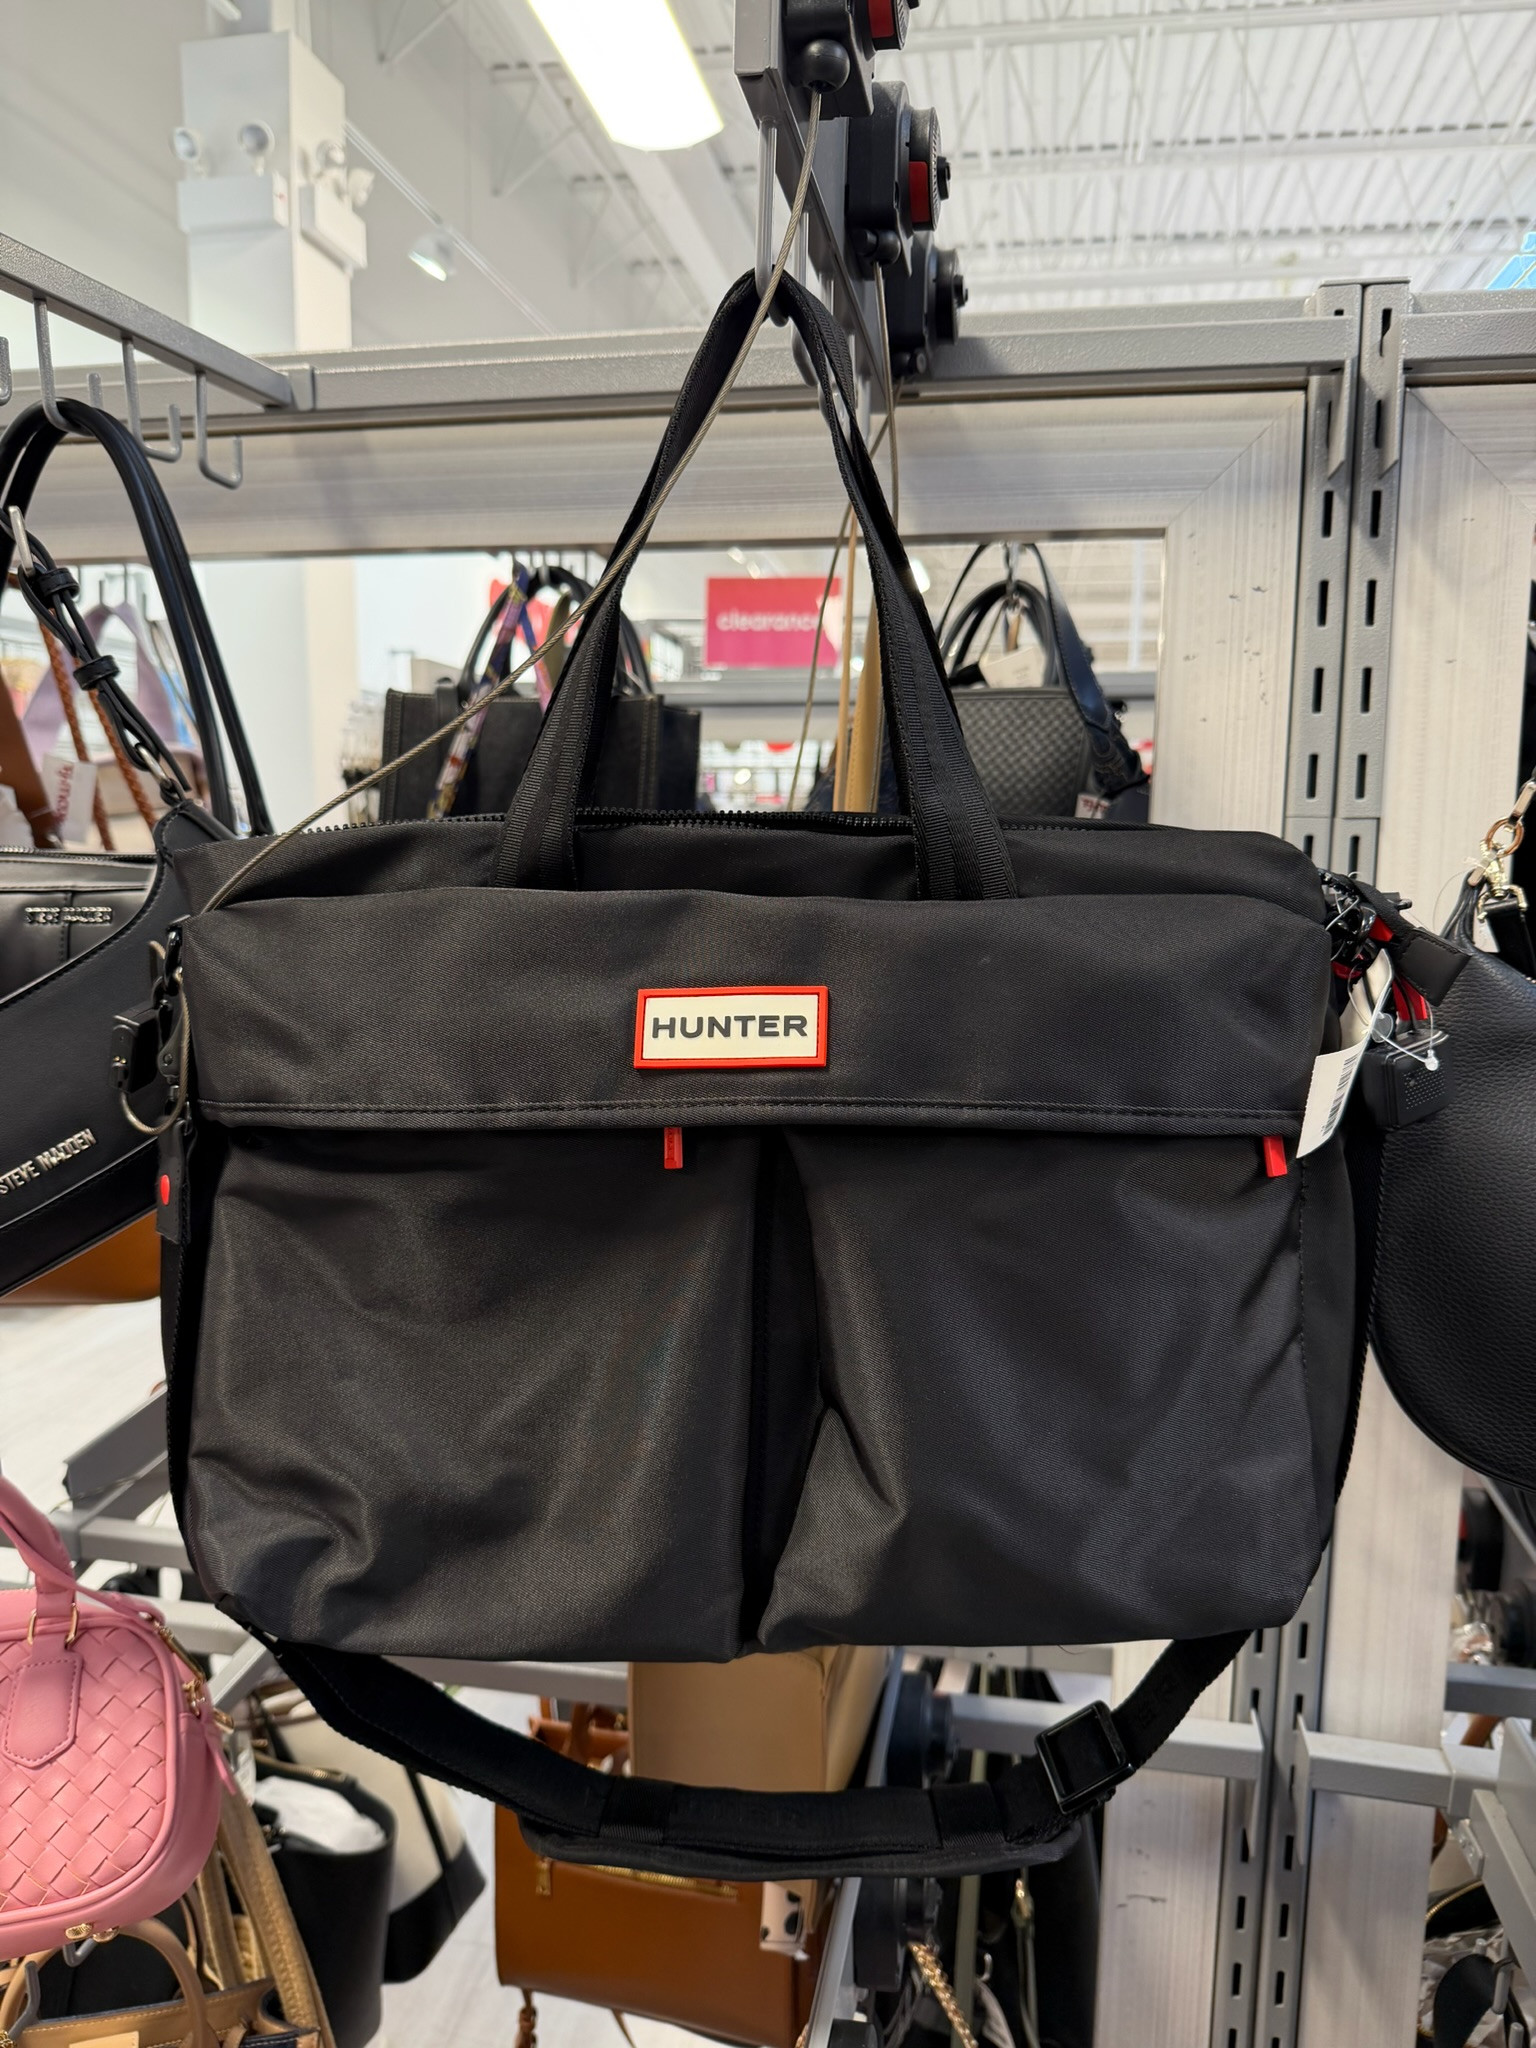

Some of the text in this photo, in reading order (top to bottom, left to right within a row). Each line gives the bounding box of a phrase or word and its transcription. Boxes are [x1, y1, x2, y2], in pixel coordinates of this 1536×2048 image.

[652, 1014, 808, 1039] HUNTER
[0, 1128, 97, 1195] STEVE MADDEN
